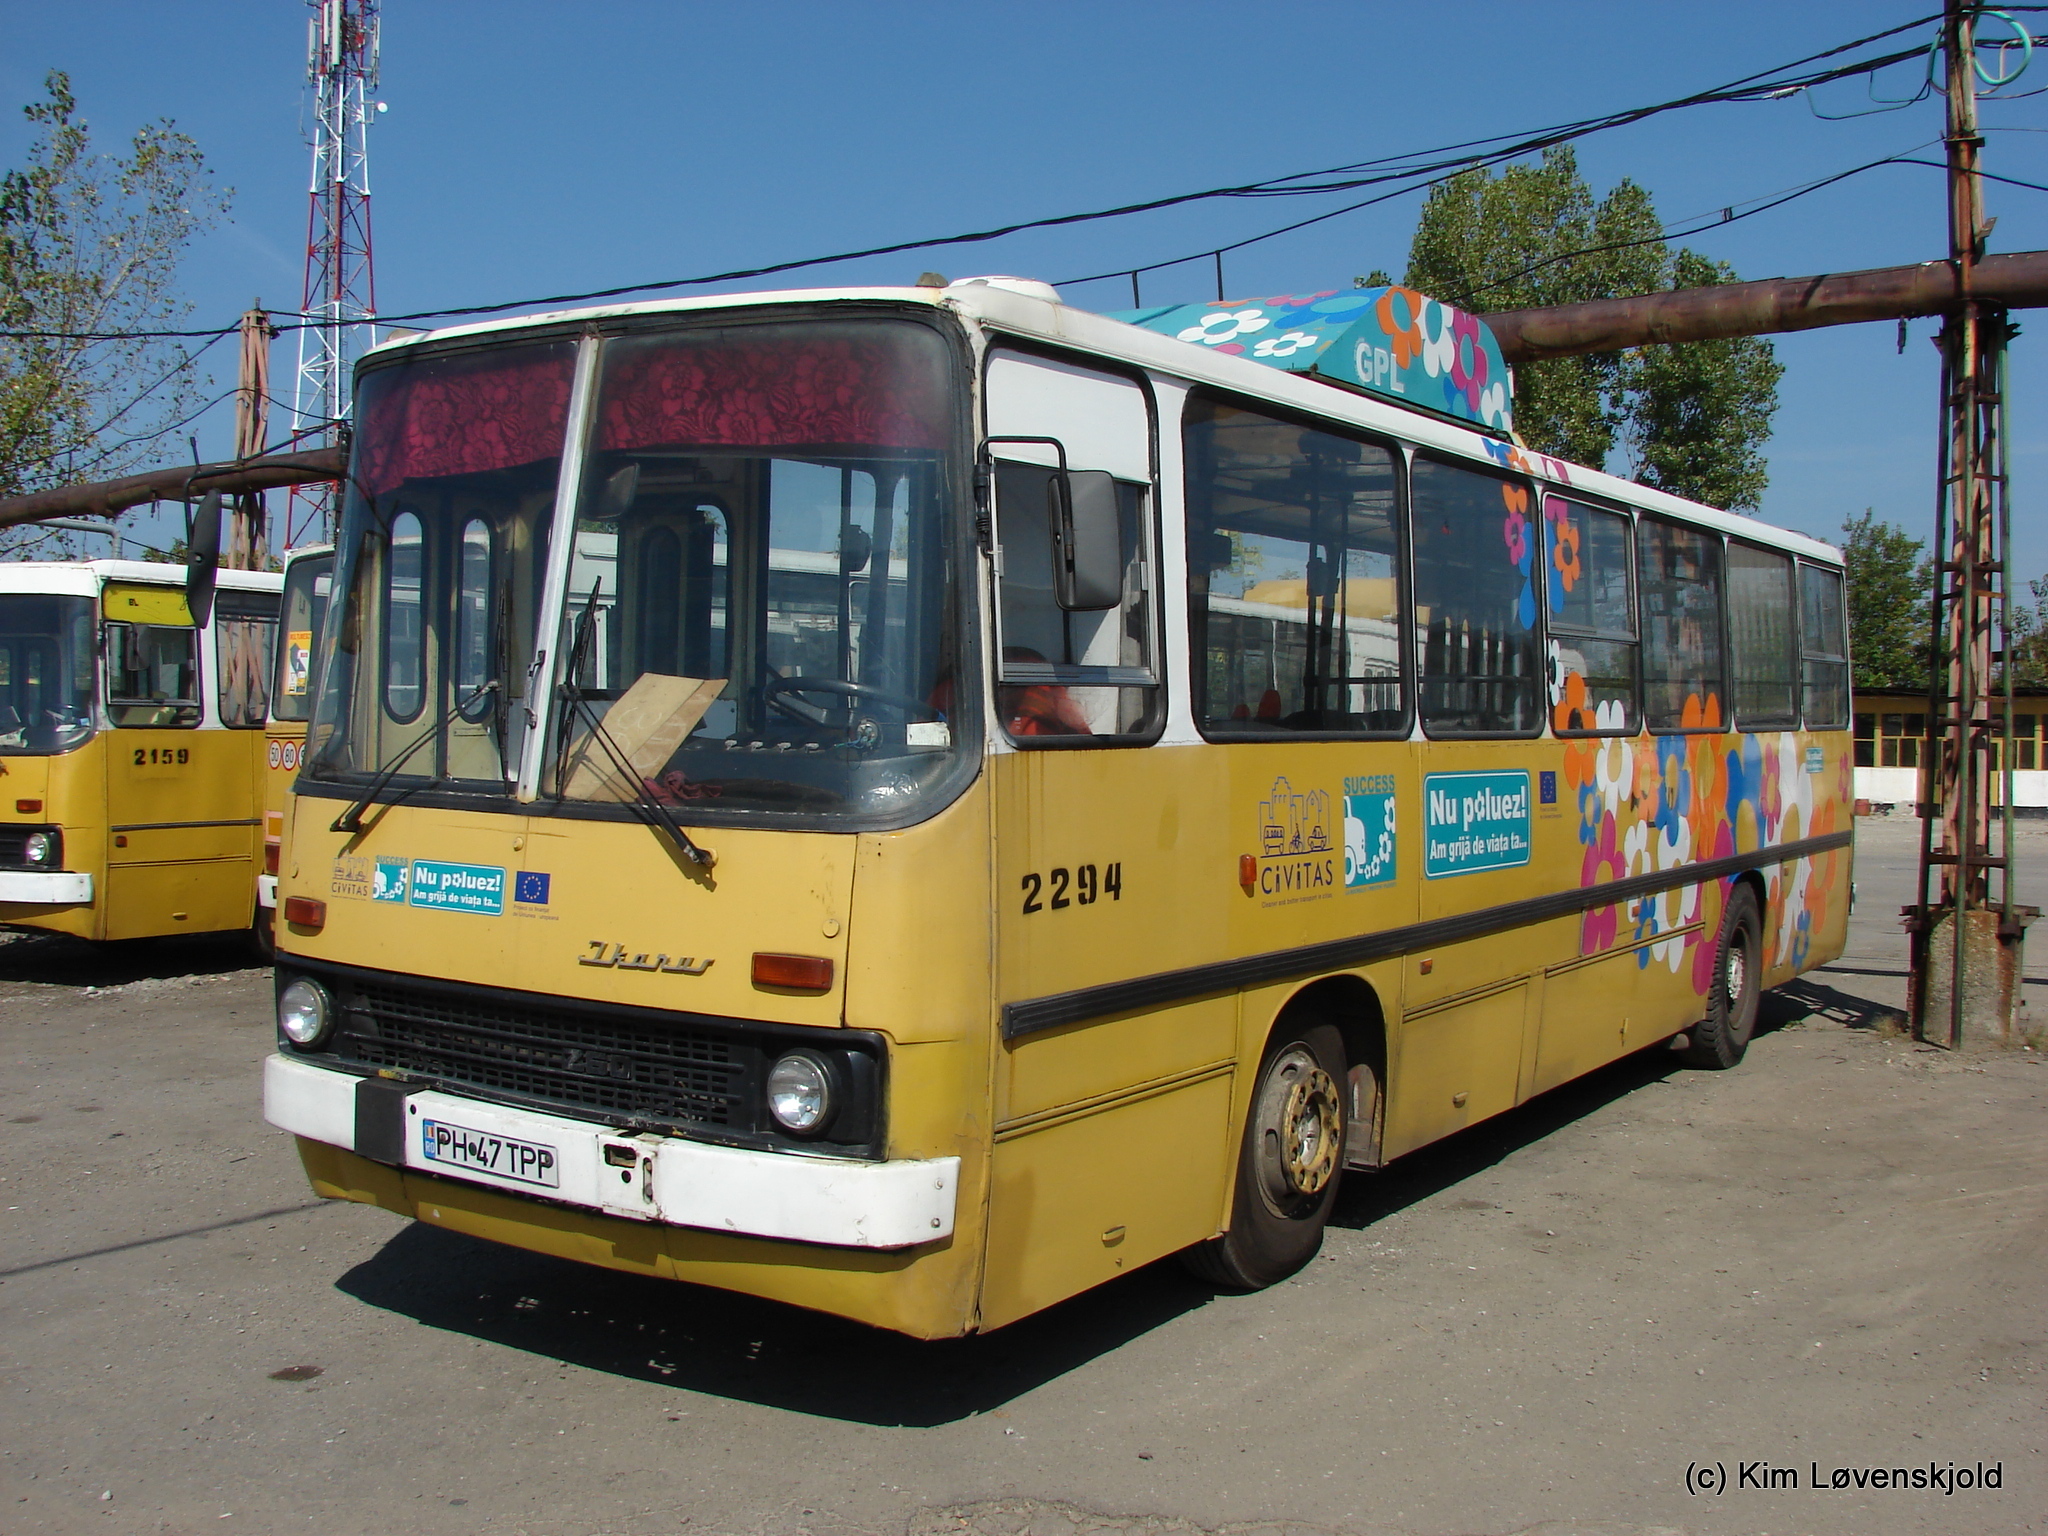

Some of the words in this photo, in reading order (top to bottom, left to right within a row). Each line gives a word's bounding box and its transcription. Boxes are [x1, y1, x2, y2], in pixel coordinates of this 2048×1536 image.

[1356, 341, 1405, 393] GPL
[134, 748, 190, 766] 2159
[270, 747, 279, 762] 50
[284, 748, 294, 763] 80
[1343, 774, 1395, 795] SUCCESS
[1430, 789, 1457, 826] Nu
[1463, 785, 1527, 832] poluez!
[1429, 839, 1447, 860] Am
[1449, 835, 1471, 863] grijă
[1472, 835, 1484, 855] de
[1510, 831, 1528, 850] ta...
[375, 855, 409, 866] SUCCESS
[415, 867, 437, 885] Nu
[441, 871, 501, 892] poluez!
[1021, 862, 1122, 915] 2294
[413, 888, 427, 899] Am
[448, 892, 460, 903] de
[483, 897, 501, 908] ta...
[577, 940, 715, 976] Ikarus
[564, 1048, 632, 1079] 260
[425, 1141, 436, 1157] RO
[435, 1126, 468, 1162] PH
[476, 1136, 501, 1168] 47
[506, 1143, 554, 1179] TPP
